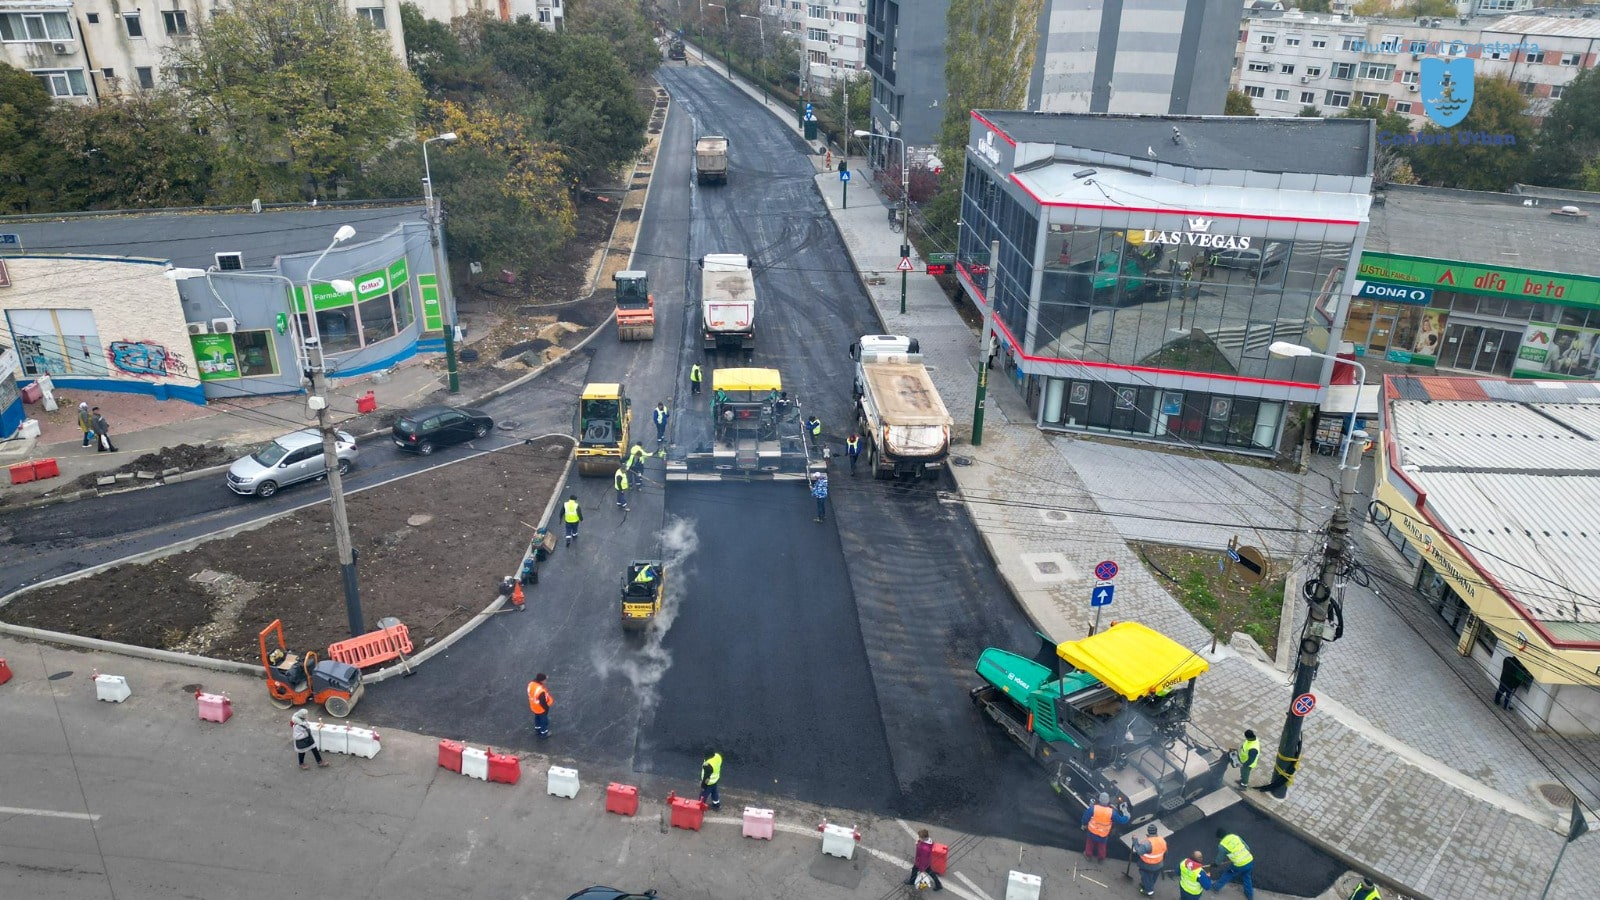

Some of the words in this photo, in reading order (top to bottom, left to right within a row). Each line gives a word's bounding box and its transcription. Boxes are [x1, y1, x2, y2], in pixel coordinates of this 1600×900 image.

[1143, 229, 1182, 245] LAS
[1185, 232, 1251, 250] VEGAS
[1357, 263, 1389, 278] USTUL
[1474, 272, 1506, 291] alfa
[1366, 285, 1407, 298] DONA
[1403, 516, 1424, 543] BANCA
[1431, 545, 1475, 598] TRANSILVANIA
